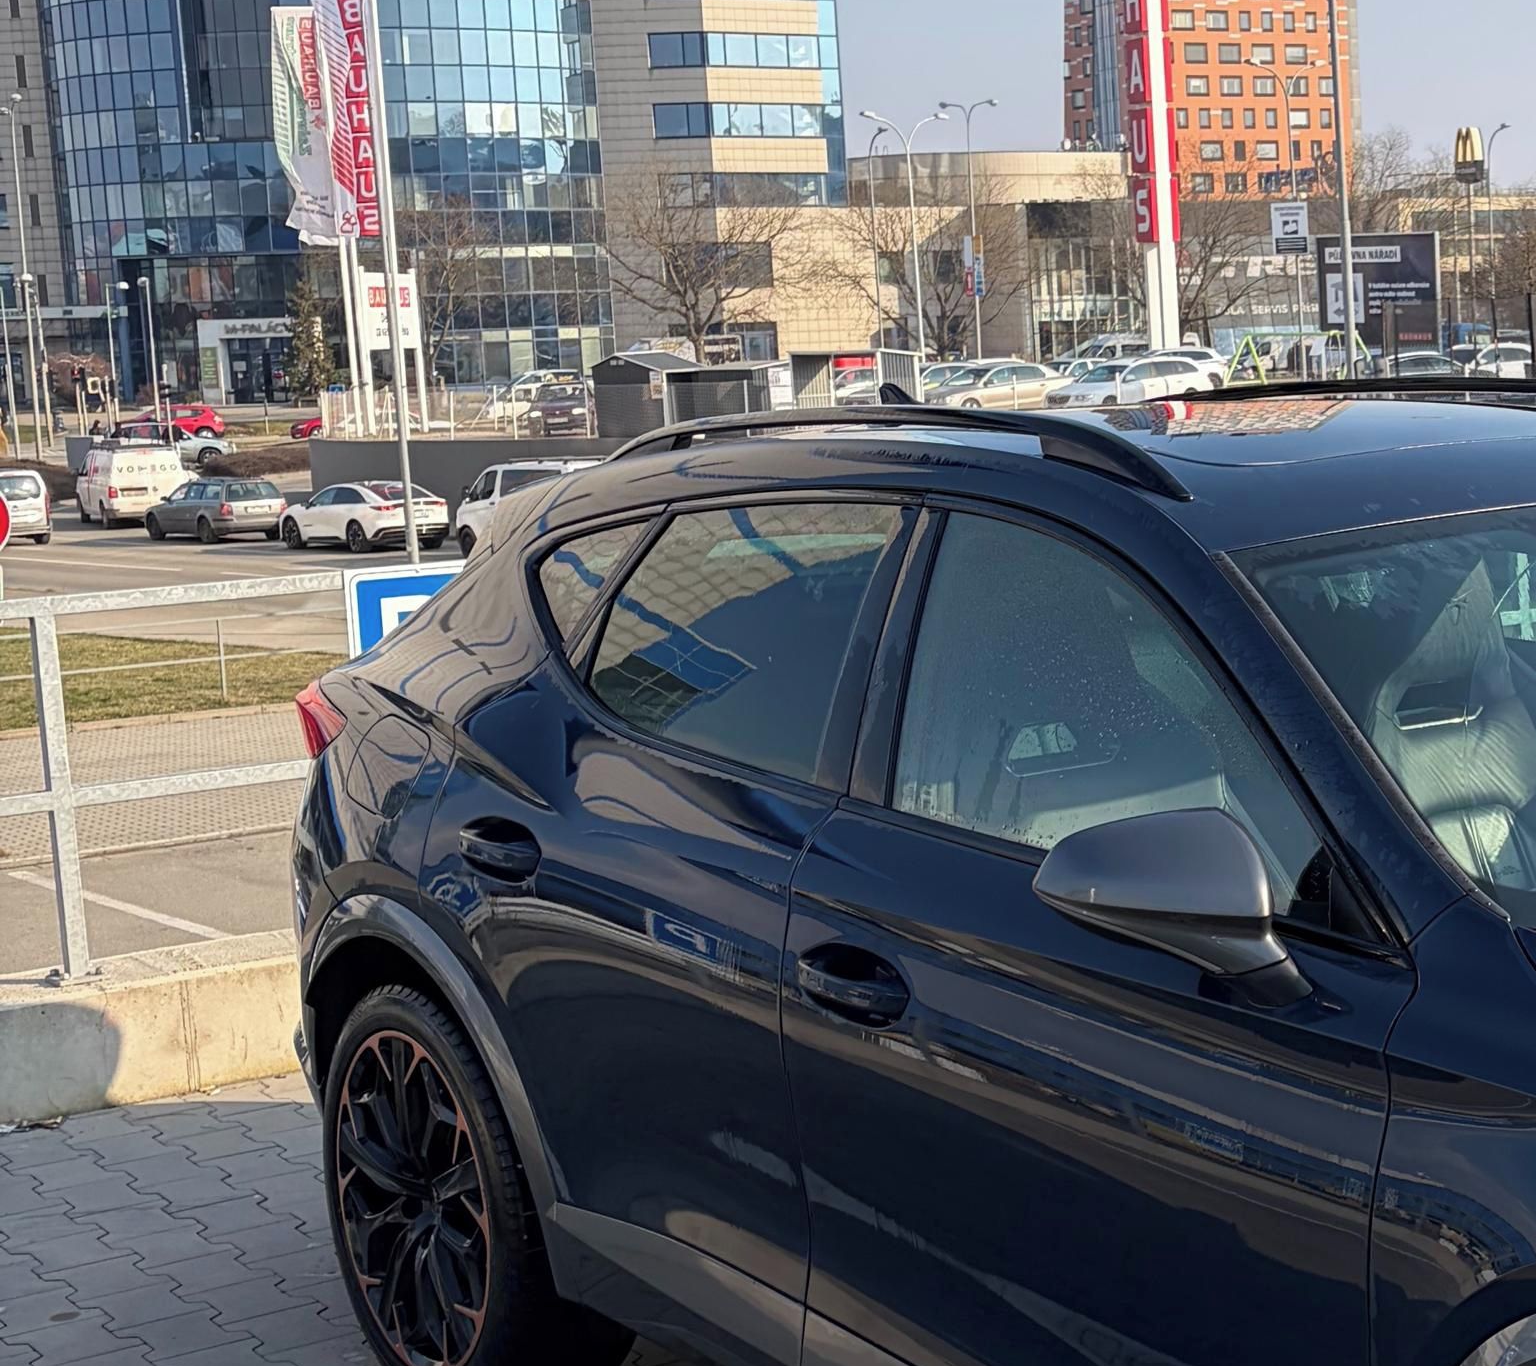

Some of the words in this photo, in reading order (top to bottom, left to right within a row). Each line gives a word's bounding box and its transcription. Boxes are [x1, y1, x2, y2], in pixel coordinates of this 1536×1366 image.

[1328, 248, 1367, 260] PŮJVNA
[368, 287, 410, 307] BAUUS
[1251, 304, 1288, 315] SERVIS
